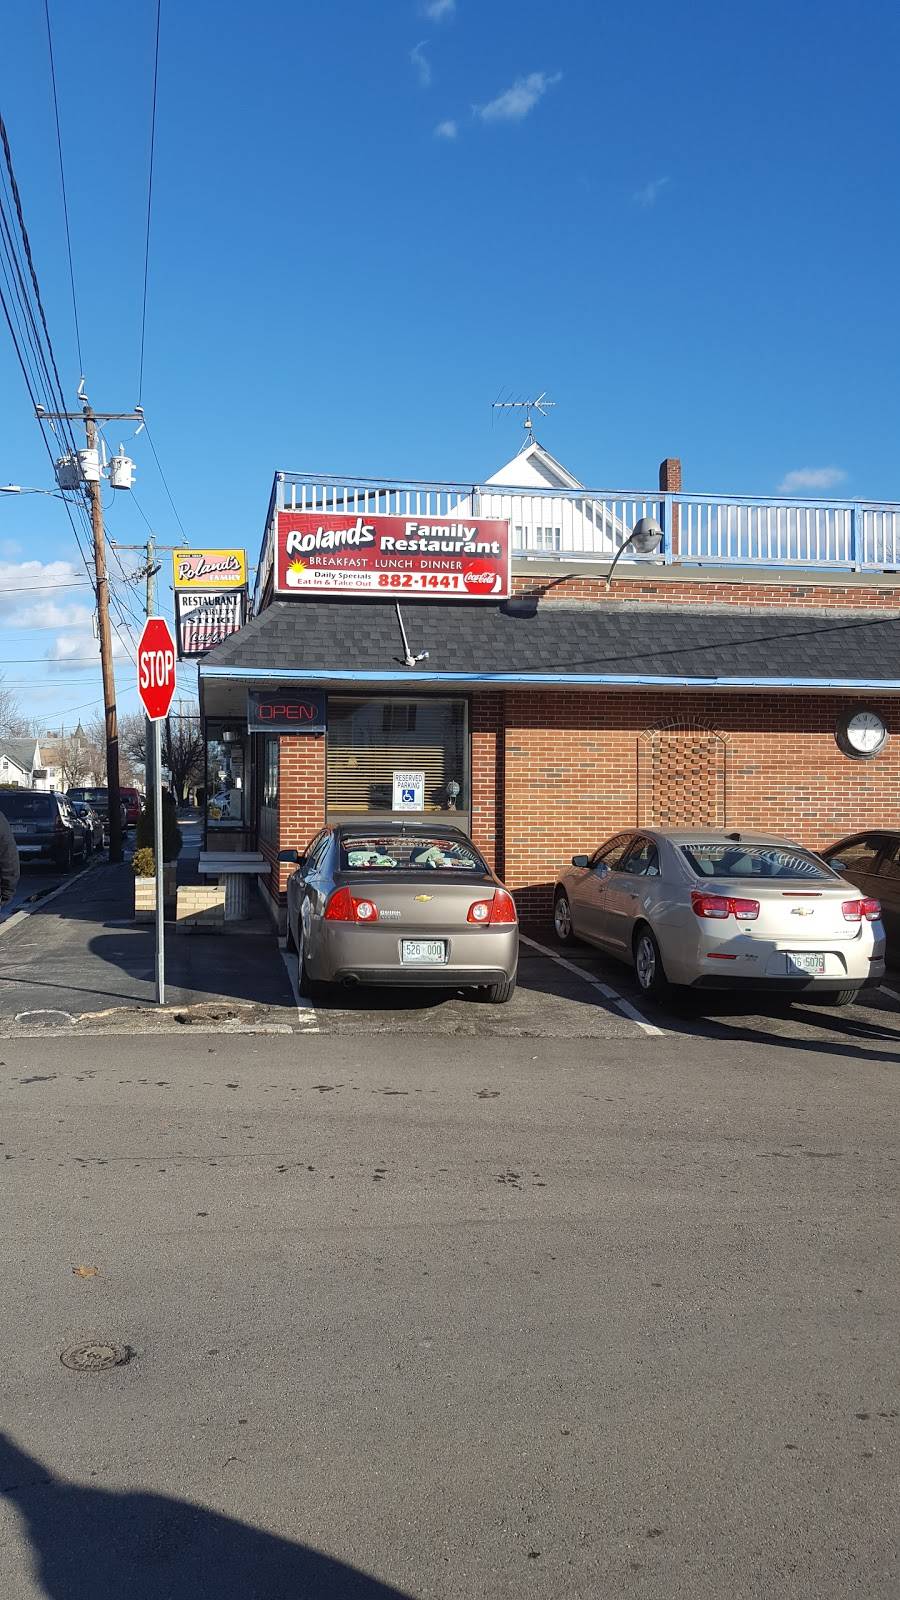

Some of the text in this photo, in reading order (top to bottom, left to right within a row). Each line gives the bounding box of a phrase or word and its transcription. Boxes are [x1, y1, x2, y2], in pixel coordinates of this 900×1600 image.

[286, 517, 375, 555] Rolands
[404, 522, 477, 541] Family
[379, 536, 500, 554] Restaurant
[179, 555, 242, 581] Roland's
[309, 557, 462, 570] BREAKFAST LUNCH DINNER
[314, 571, 372, 580] Daily Specials
[378, 574, 459, 589] 882-1441
[464, 571, 496, 584] Coca-Cola
[333, 579, 353, 587] Take
[182, 596, 238, 606] RESTAURANT
[198, 608, 237, 616] VARIETY
[187, 617, 236, 625] STORE
[140, 650, 174, 689] STOP
[258, 705, 315, 720] OPEN
[395, 774, 423, 782] RESERVED
[397, 781, 420, 790] PARKING
[406, 944, 442, 955] 526 000
